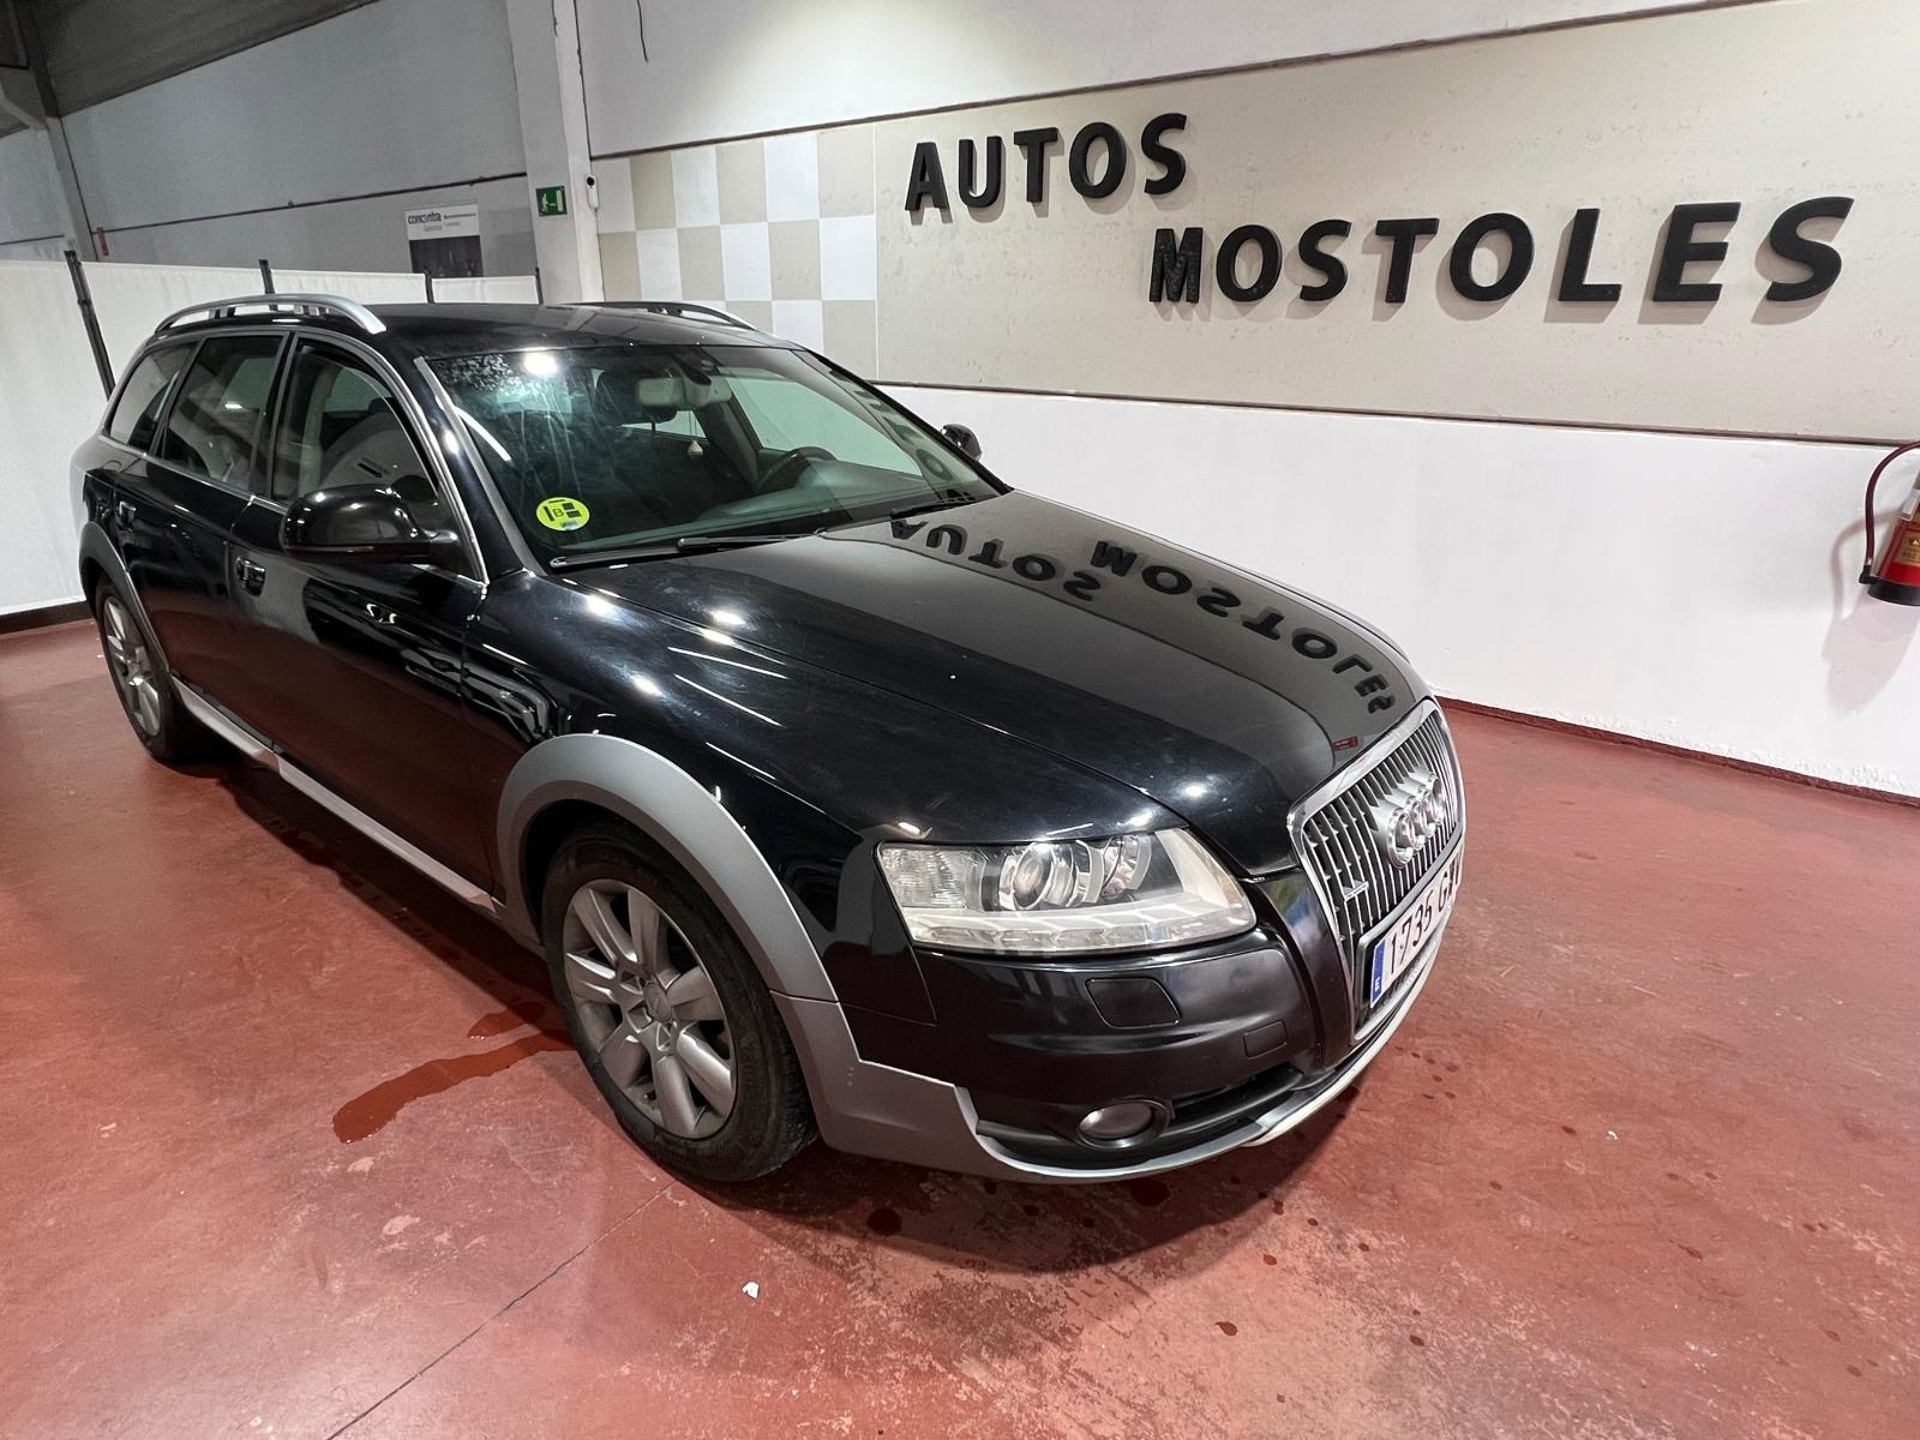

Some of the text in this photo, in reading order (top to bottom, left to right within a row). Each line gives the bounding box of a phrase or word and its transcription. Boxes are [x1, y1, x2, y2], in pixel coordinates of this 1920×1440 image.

[905, 113, 1188, 211] AUTOS
[1149, 197, 1855, 303] MOSTOLES
[1391, 889, 1434, 976] 1735
